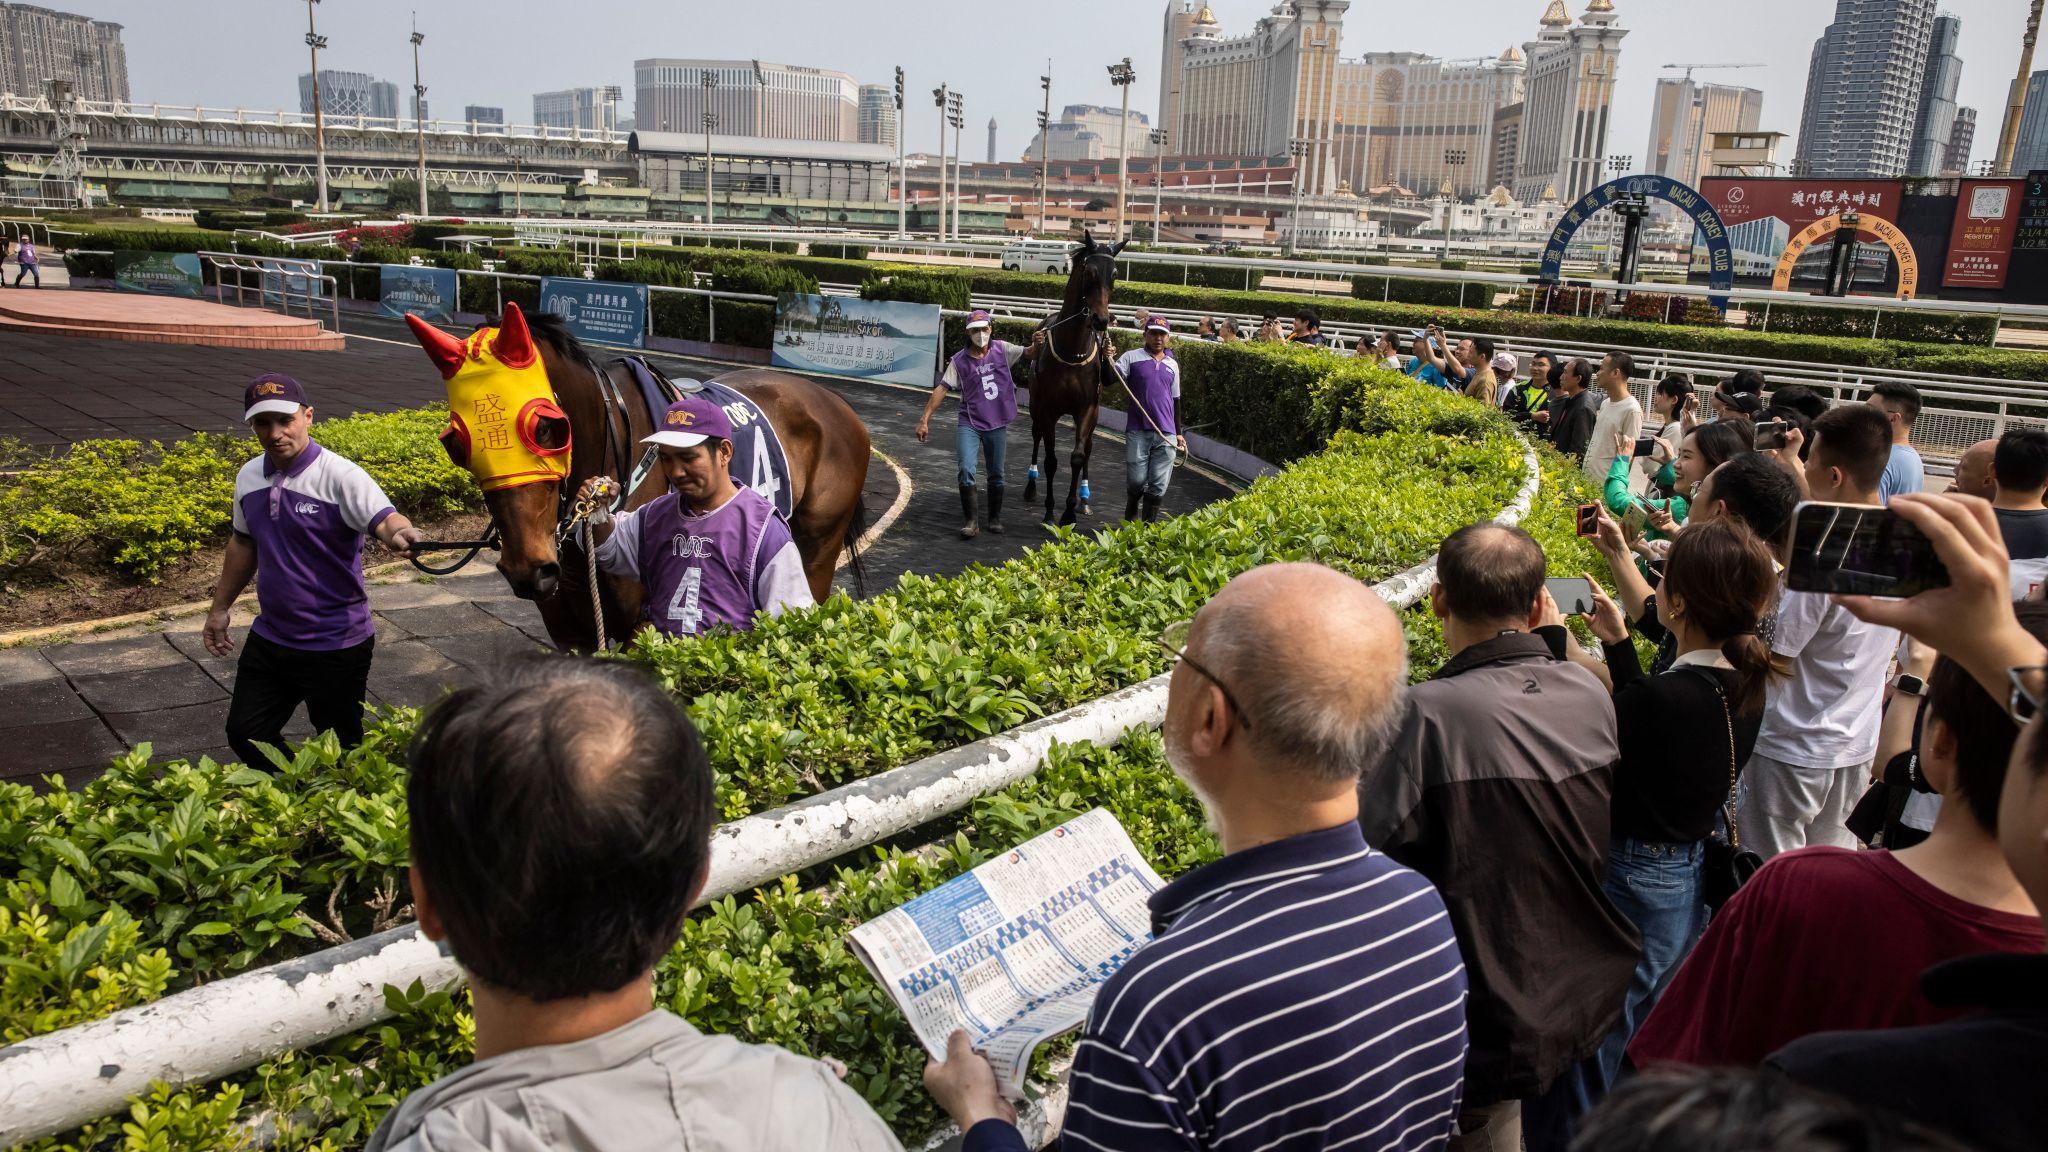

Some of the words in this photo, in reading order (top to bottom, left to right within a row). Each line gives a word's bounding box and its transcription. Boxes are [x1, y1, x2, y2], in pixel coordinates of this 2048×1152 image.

[1668, 185, 1697, 209] MACAU
[1697, 209, 1722, 240] JOCKEY
[1714, 248, 1729, 272] CLUB
[1873, 222, 1896, 240] MACAU
[1894, 240, 1911, 264] JOCKEY
[1903, 267, 1914, 285] CLUB
[857, 325, 883, 337] SAKOR
[981, 374, 999, 400] 5
[473, 393, 514, 452] 盛通
[751, 425, 780, 506] 4
[667, 566, 703, 634] 4
